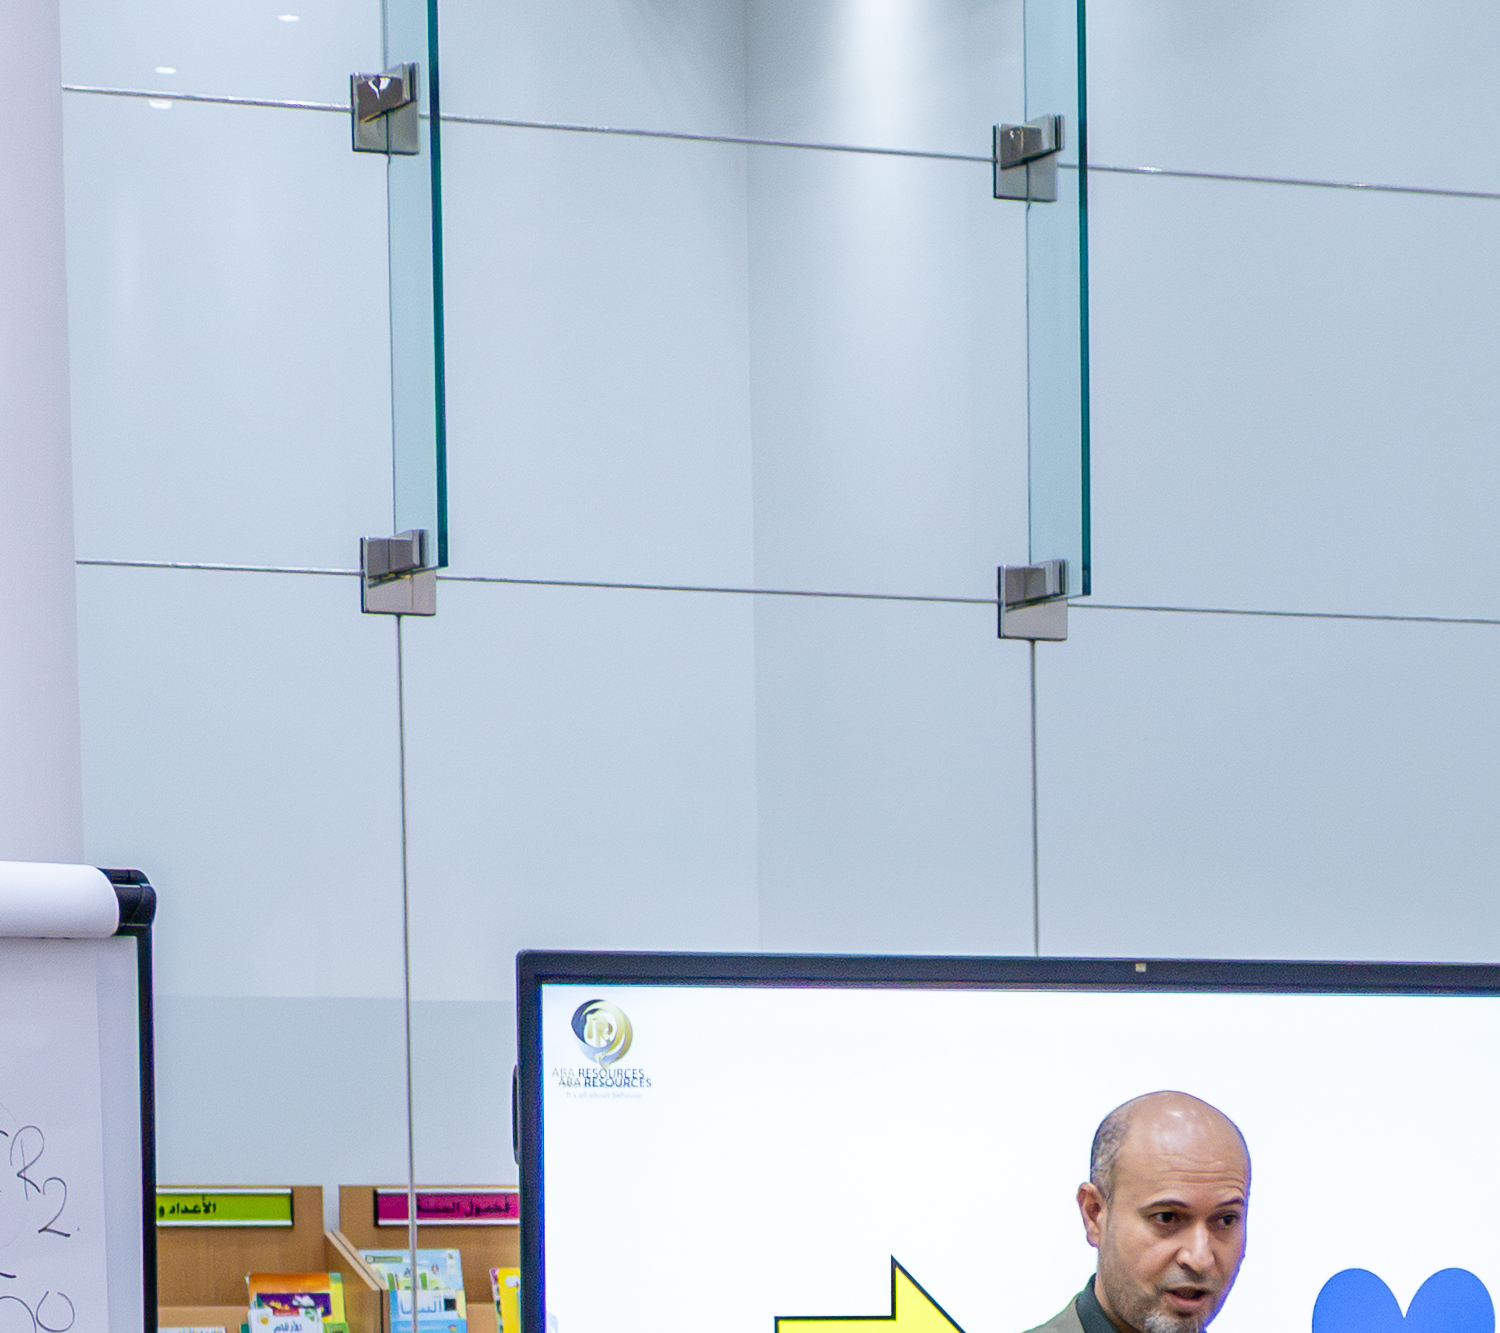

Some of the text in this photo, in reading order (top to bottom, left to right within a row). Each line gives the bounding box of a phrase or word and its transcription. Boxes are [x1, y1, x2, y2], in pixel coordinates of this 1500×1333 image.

[578, 1067, 645, 1079] RESOURCES
[584, 1078, 652, 1088] RESOURCES
[169, 1195, 216, 1215] الأعداد
